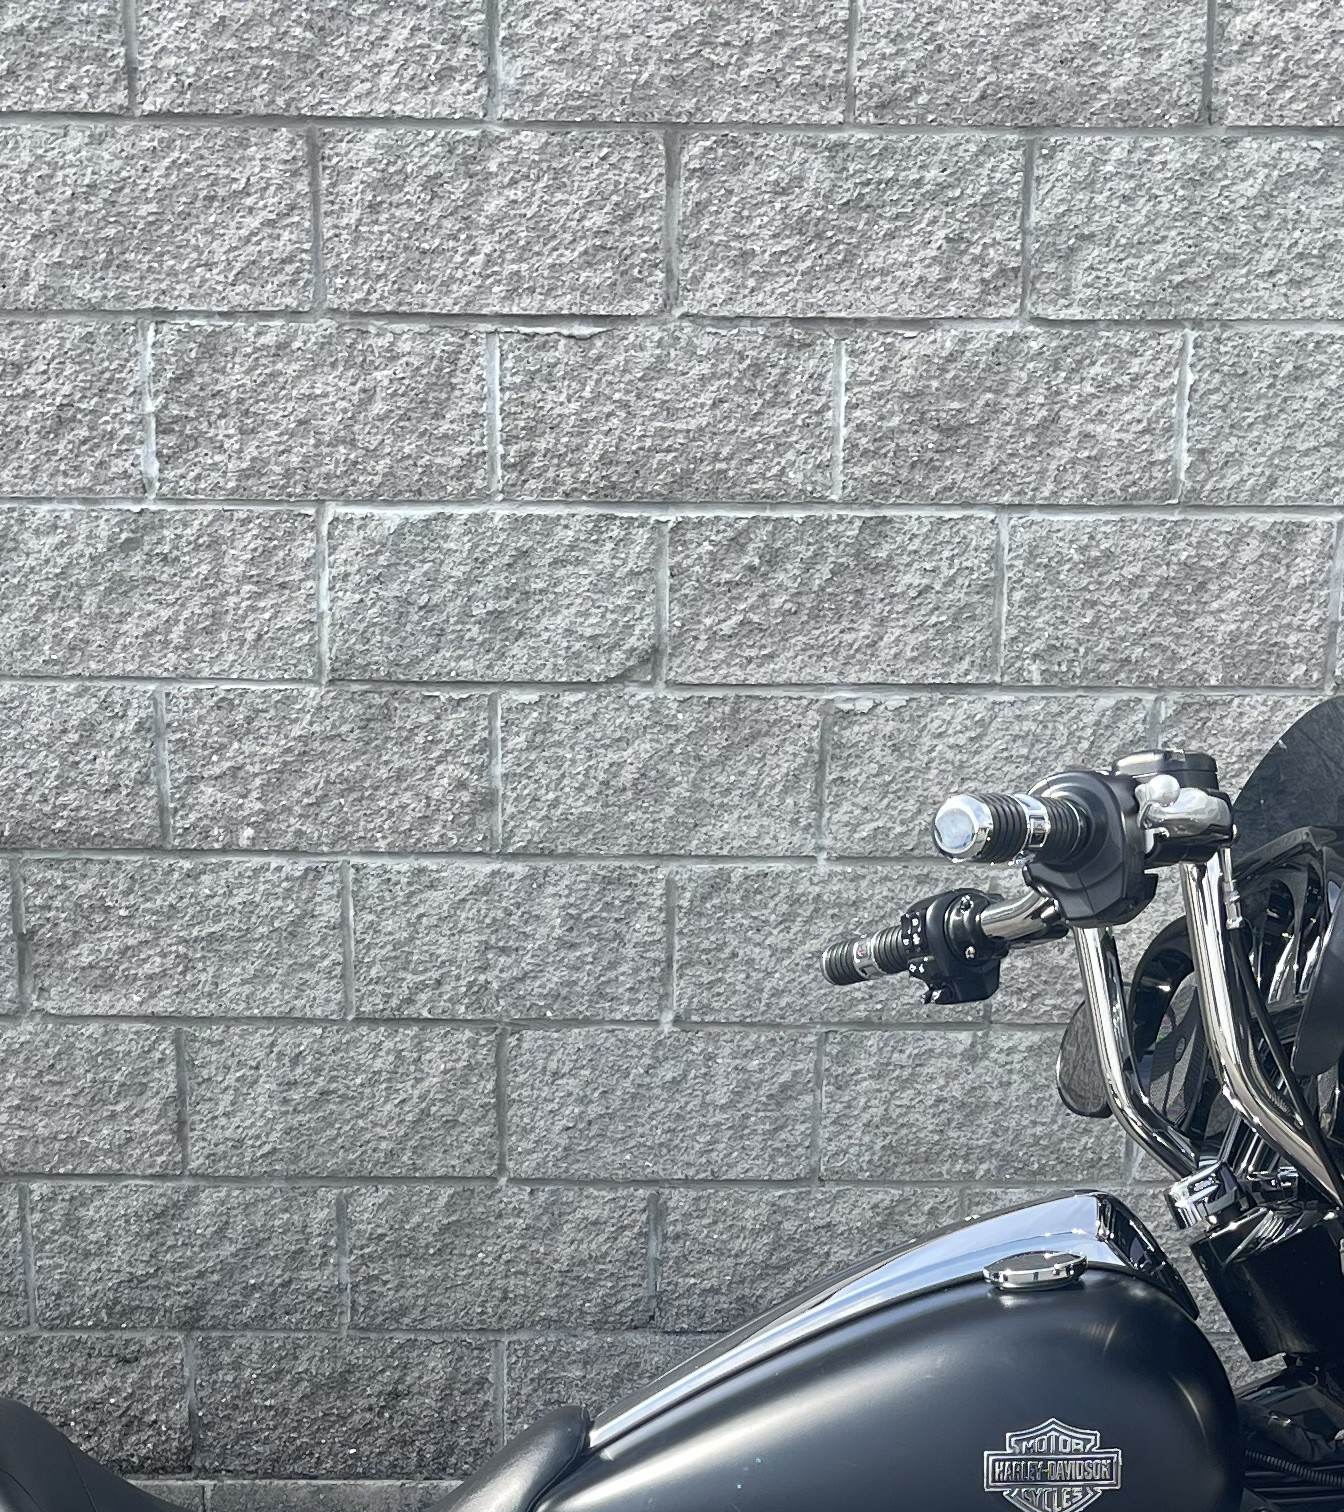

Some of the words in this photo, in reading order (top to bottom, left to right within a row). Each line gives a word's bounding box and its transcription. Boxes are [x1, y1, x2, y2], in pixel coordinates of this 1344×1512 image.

[1022, 1431, 1084, 1454] MOTOR
[994, 1459, 1111, 1482] HARLEY-DAVIDSON
[1021, 1486, 1083, 1512] CYCLES
